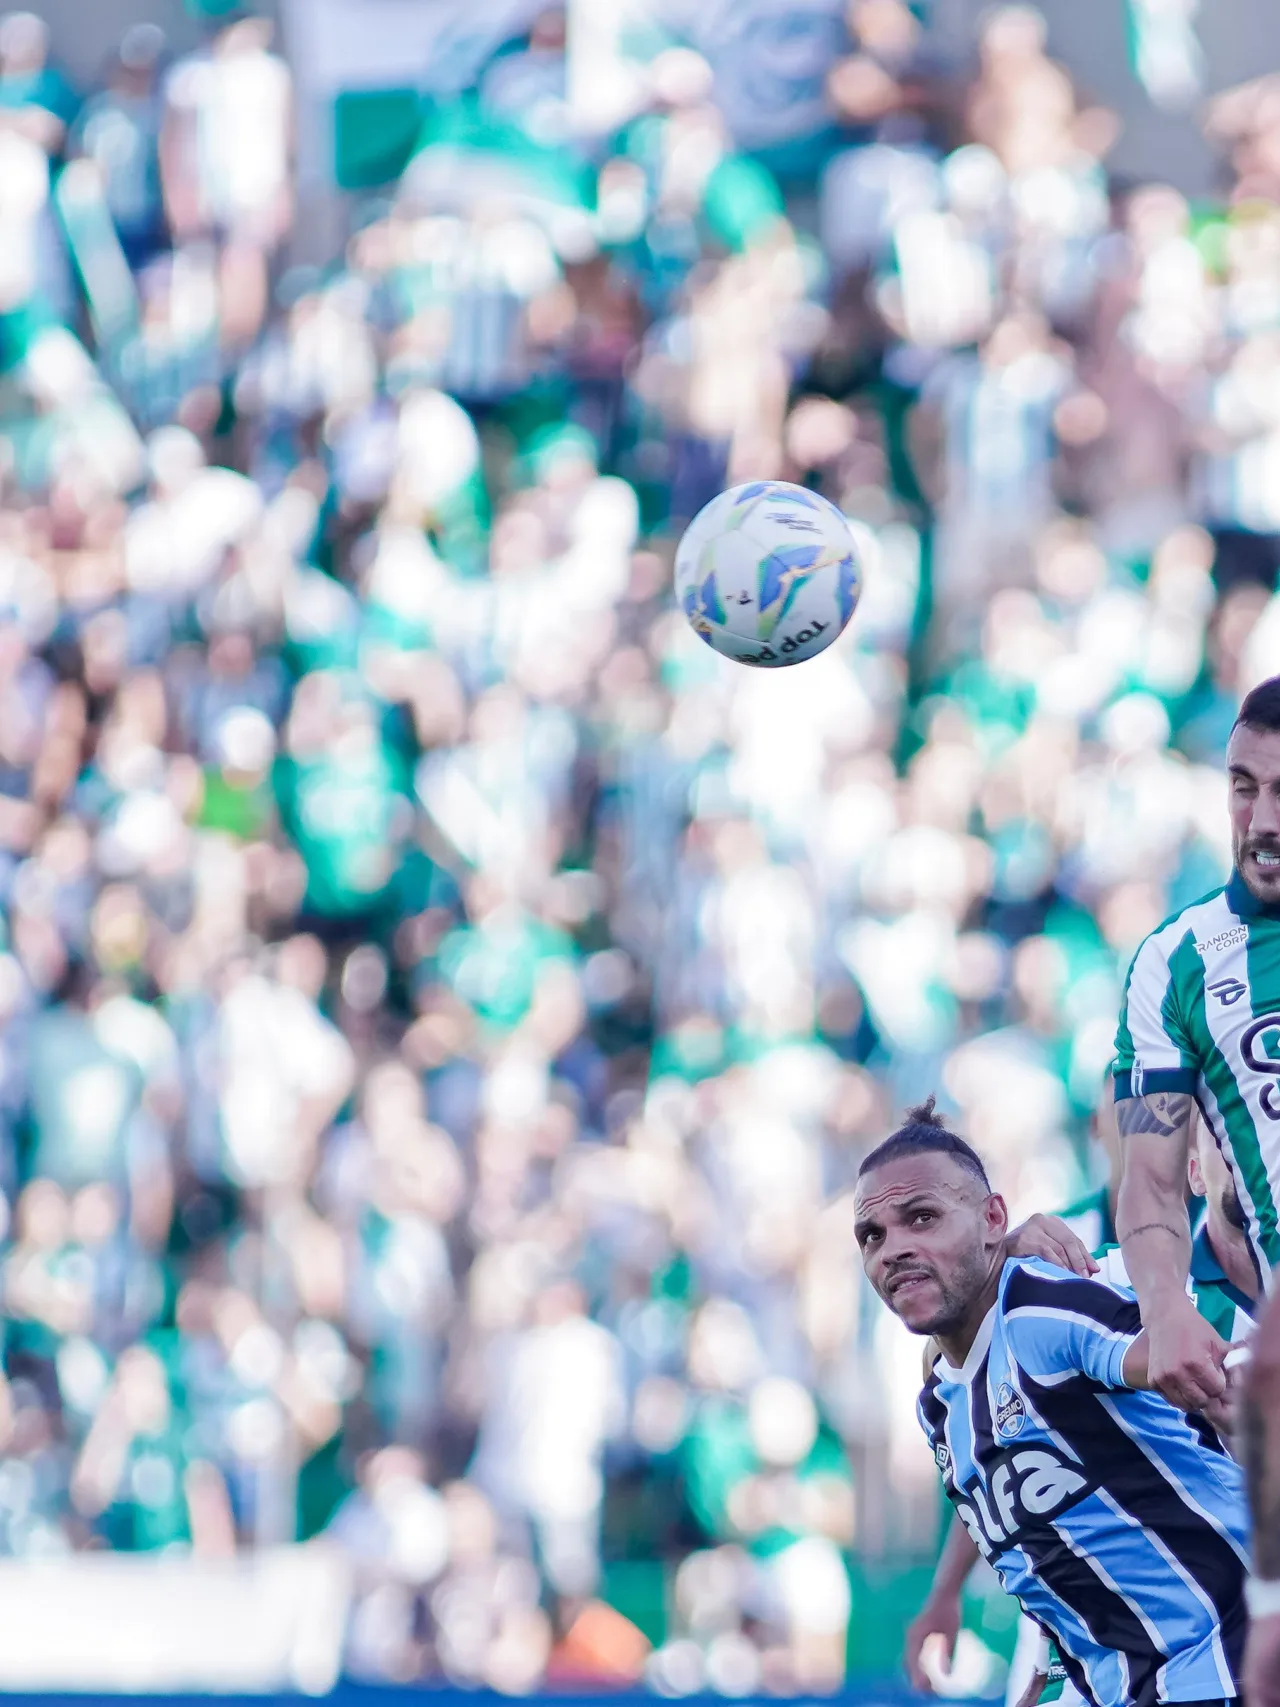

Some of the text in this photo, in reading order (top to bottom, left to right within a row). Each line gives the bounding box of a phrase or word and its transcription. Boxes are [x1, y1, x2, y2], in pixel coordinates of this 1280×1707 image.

[1198, 925, 1247, 952] RANDON
[1215, 933, 1248, 952] CORP
[956, 1450, 1088, 1557] alfa
